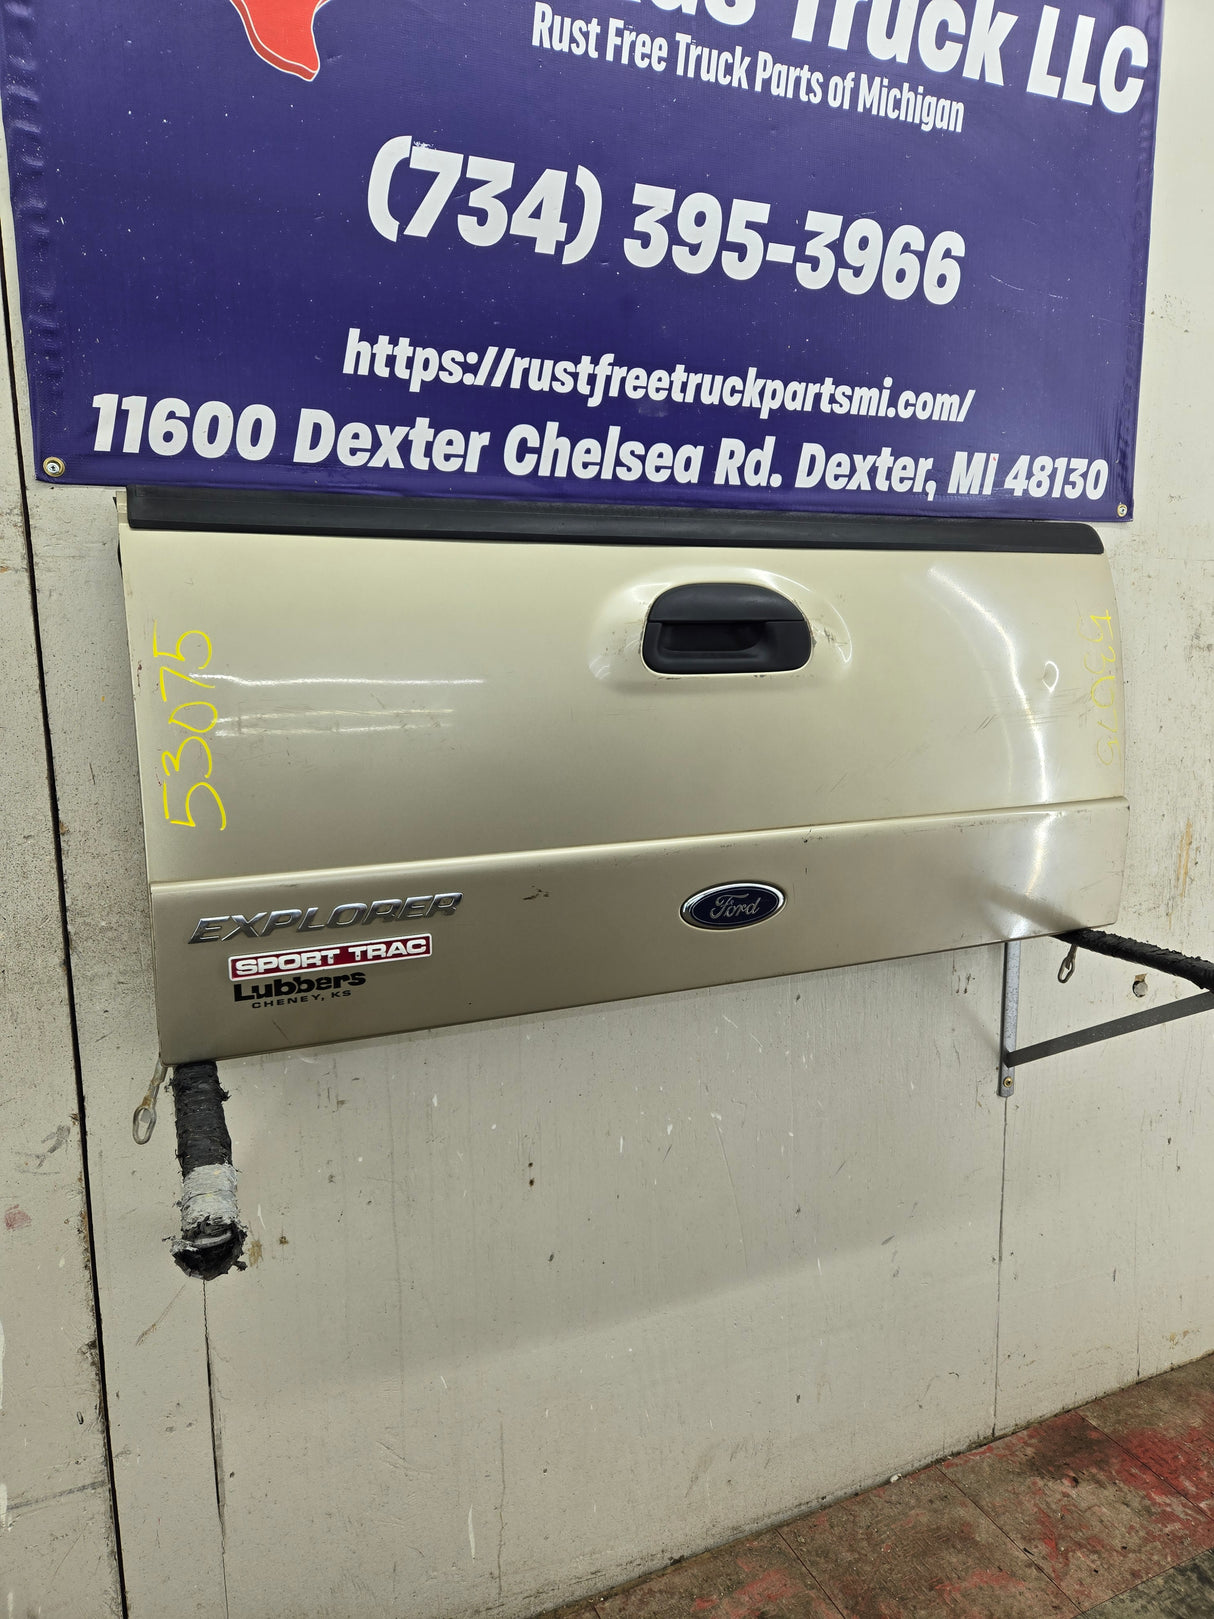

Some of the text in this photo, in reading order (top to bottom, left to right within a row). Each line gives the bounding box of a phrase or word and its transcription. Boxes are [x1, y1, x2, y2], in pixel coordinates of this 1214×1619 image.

[532, 2, 601, 58] Rust
[606, 18, 668, 71] Free
[675, 32, 751, 89] Truck
[755, 51, 823, 104] Parts
[828, 72, 855, 109] of
[857, 74, 964, 133] Michigan
[1026, 5, 1149, 113] LLC
[368, 136, 965, 305] (734) 395-3966
[343, 328, 976, 422] https://rustfreetruckpartsmi.com/
[93, 394, 1108, 501] 11600 Dexter Chelsea Rd. Dexter, MI 48130
[152, 619, 227, 831] 53075
[188, 892, 463, 944] EXPLORER
[709, 893, 761, 919] Ford
[233, 971, 367, 1002] Lubbers
[235, 939, 427, 975] SPORT TRAC
[251, 990, 351, 1009] CHENEY, KS
